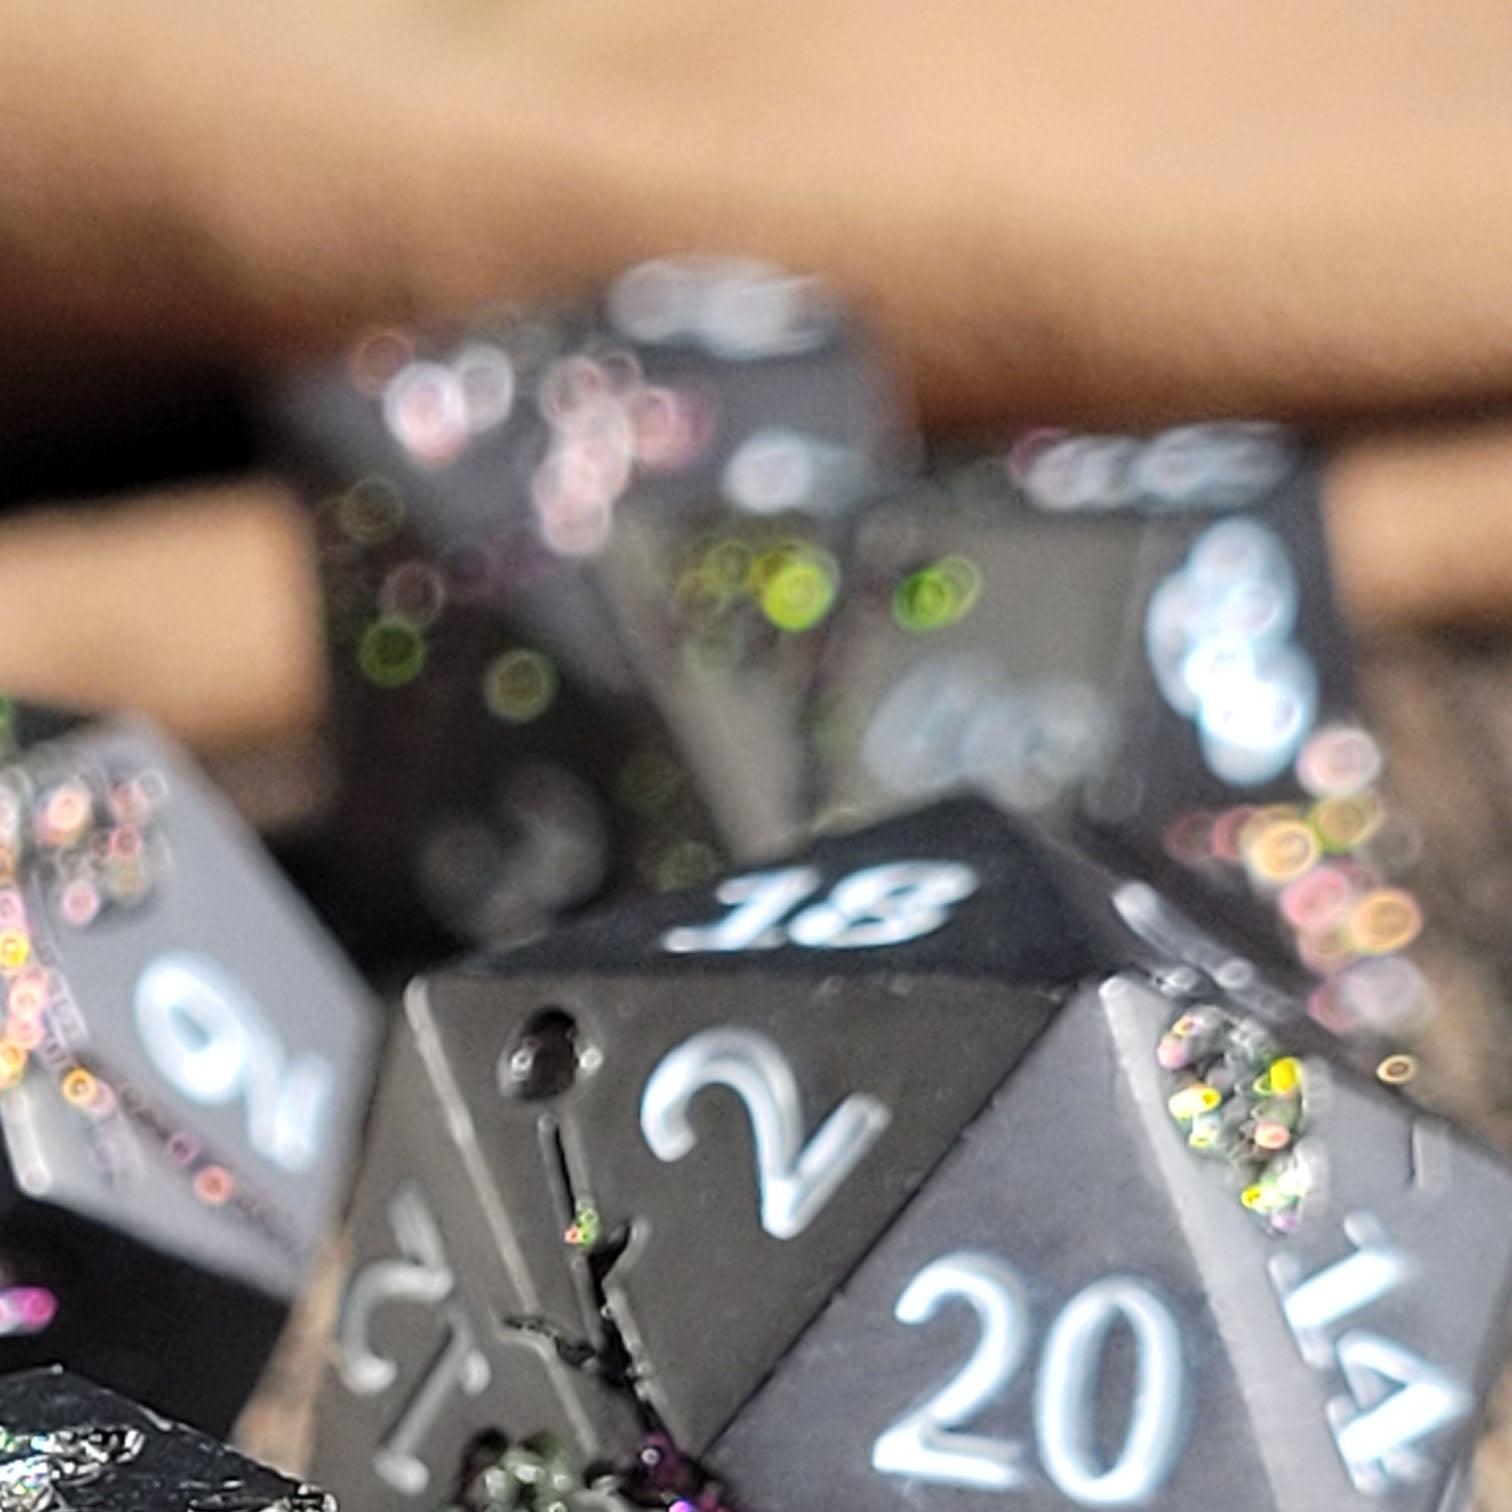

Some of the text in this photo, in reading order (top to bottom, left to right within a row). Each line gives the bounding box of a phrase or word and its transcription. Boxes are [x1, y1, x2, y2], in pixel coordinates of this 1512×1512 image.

[660, 858, 982, 954] 18
[640, 1025, 890, 1240] 2
[872, 1253, 1186, 1505] 20
